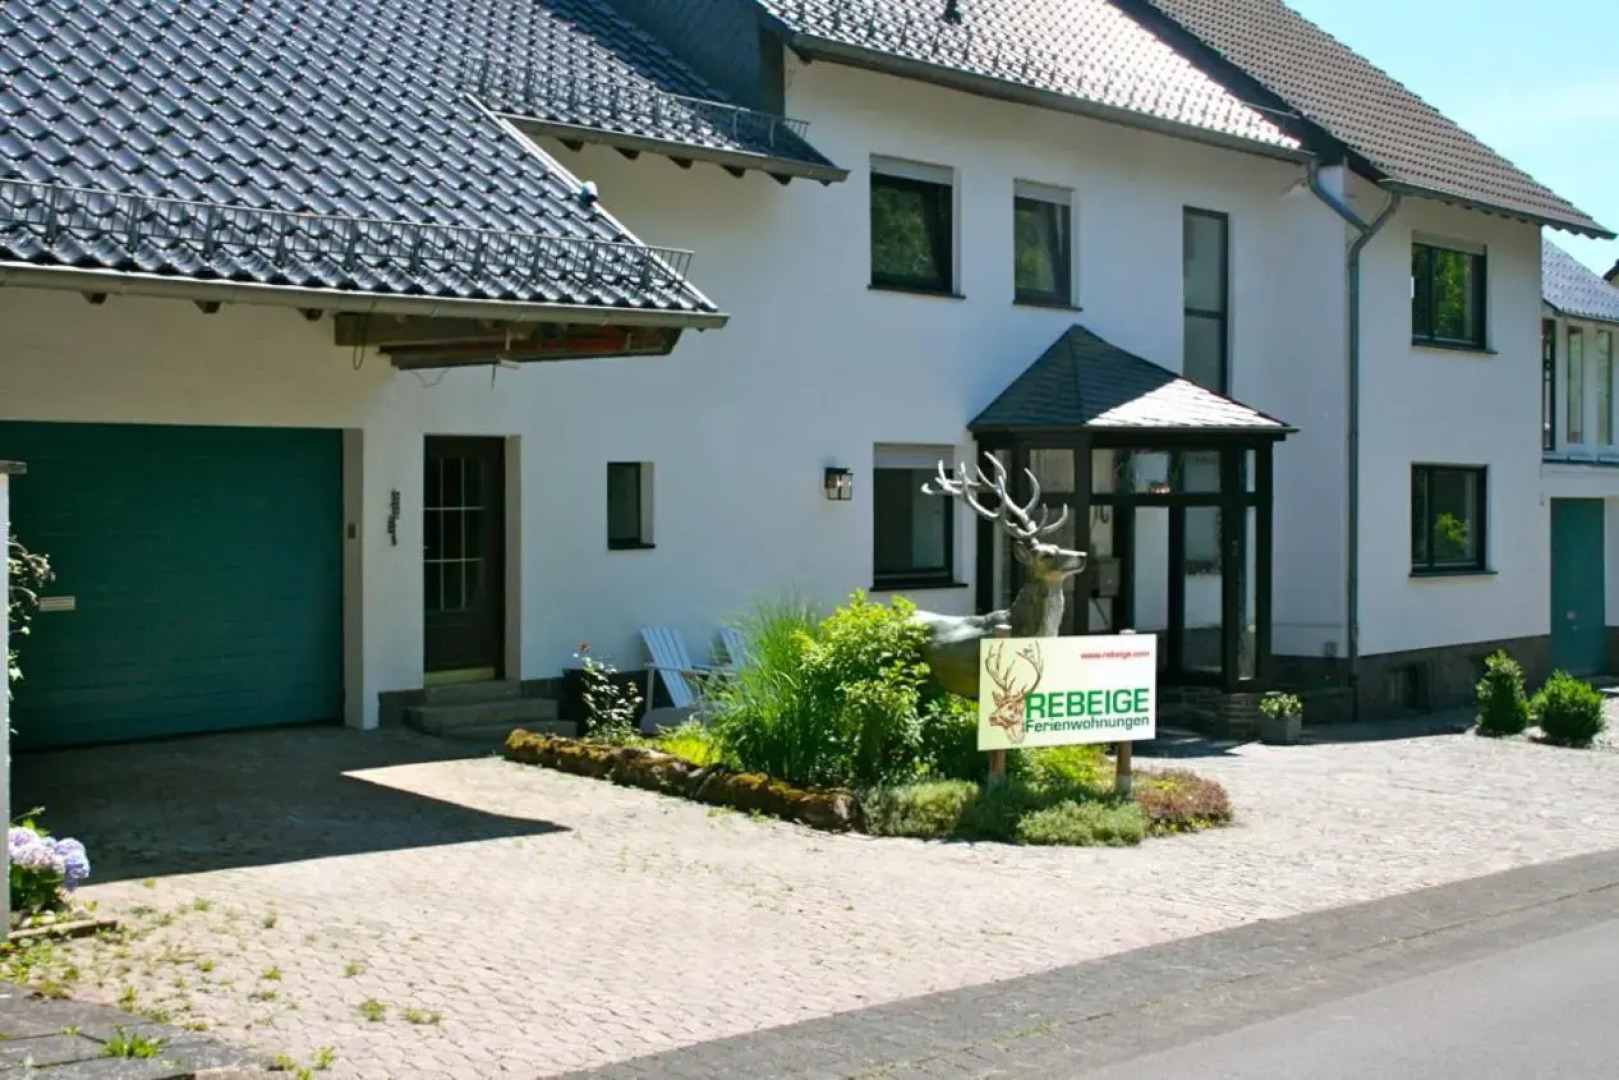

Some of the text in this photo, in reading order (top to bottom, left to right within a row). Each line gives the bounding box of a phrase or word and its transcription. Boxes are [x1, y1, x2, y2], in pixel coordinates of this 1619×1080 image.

[1080, 650, 1150, 660] www.rebeige.com
[1025, 688, 1150, 718] REBEIGE
[1025, 716, 1150, 732] Ferienwohnungen
